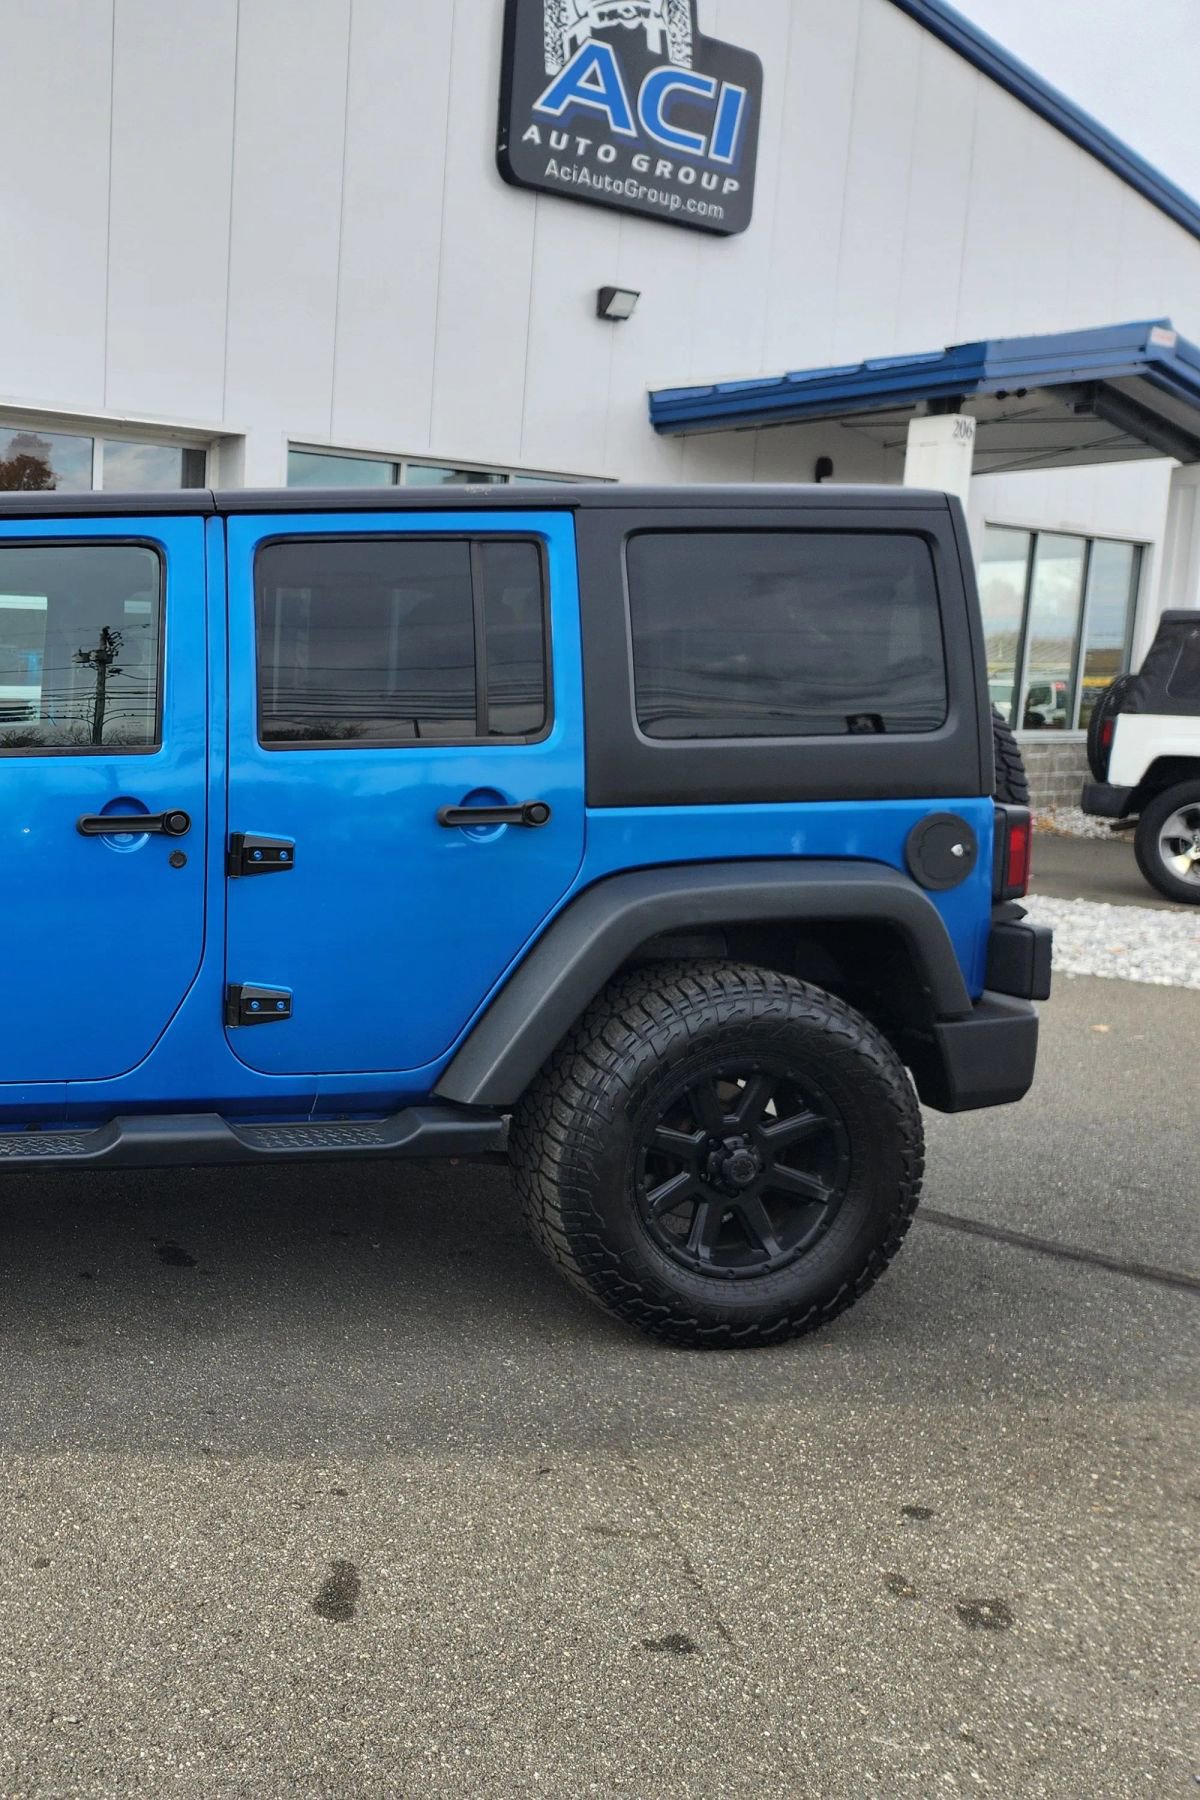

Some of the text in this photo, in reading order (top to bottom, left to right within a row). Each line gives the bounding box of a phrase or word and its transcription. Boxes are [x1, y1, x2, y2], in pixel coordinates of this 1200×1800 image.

[532, 37, 748, 164] ACI
[521, 124, 741, 195] AUTO GROUP
[544, 158, 724, 220] AciAutoGroup.com
[952, 419, 974, 440] 206
